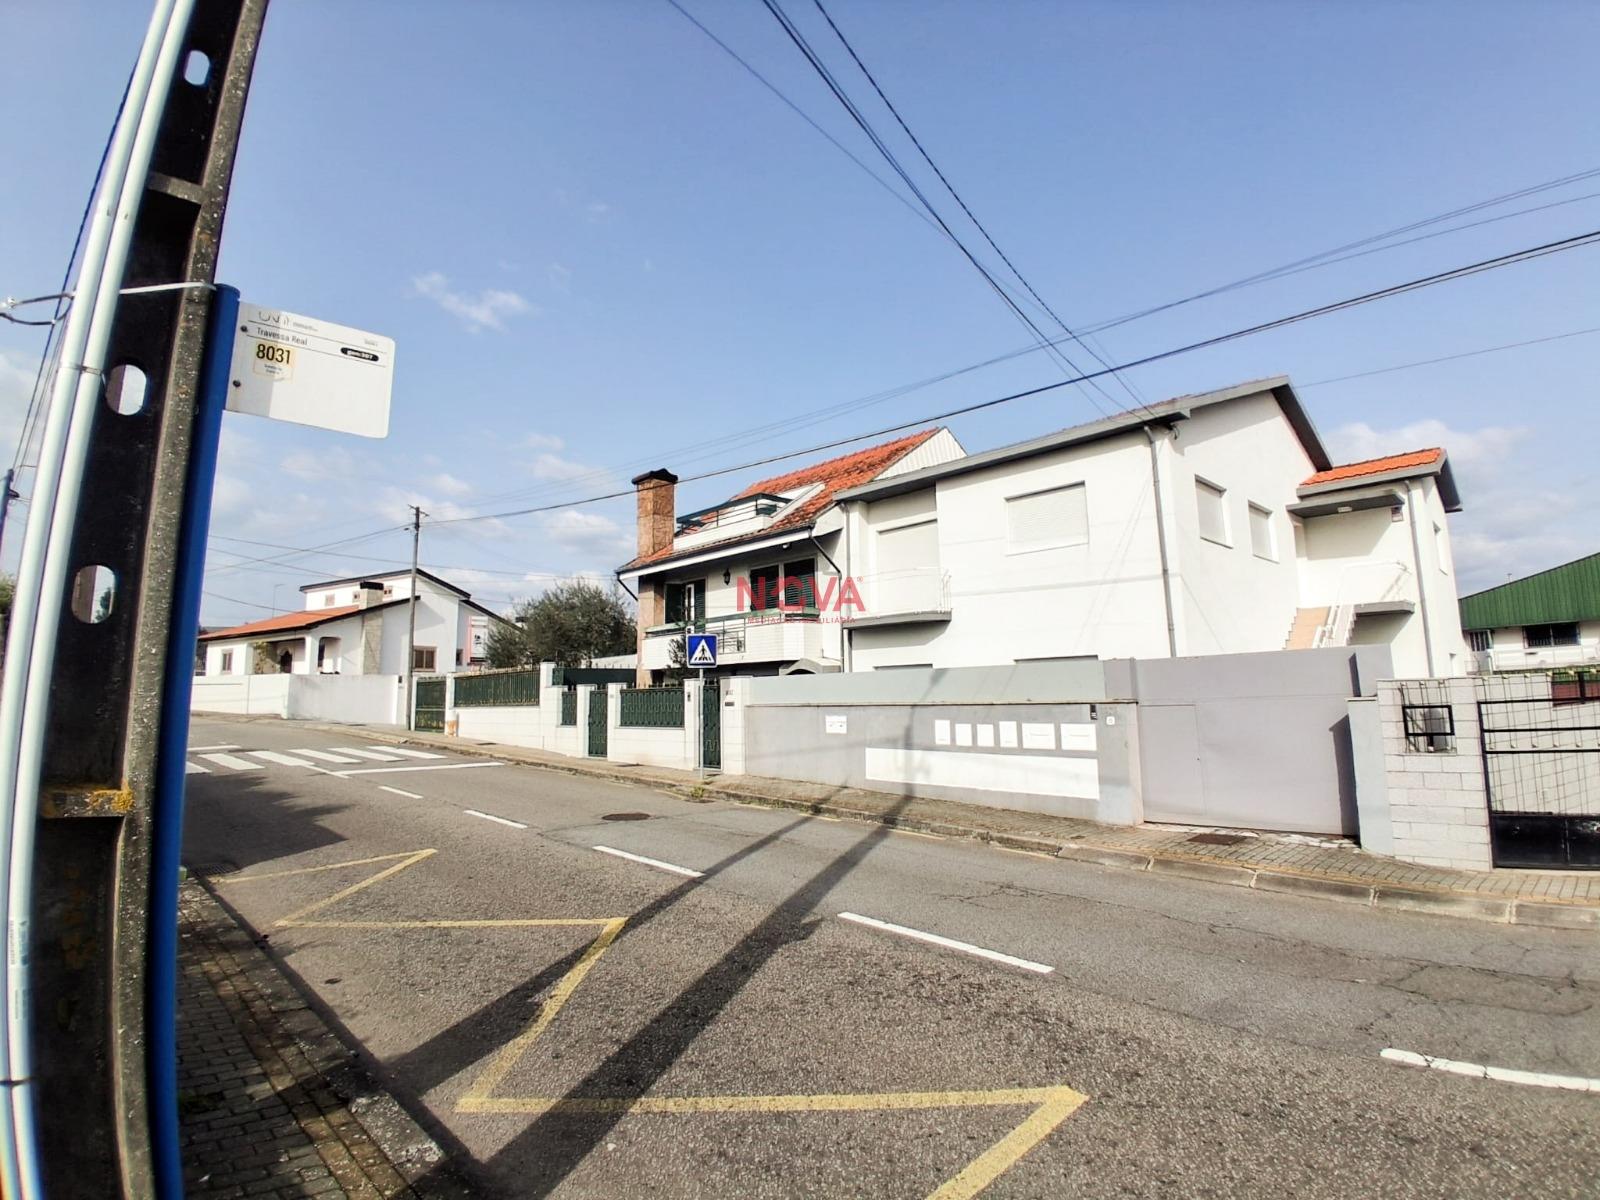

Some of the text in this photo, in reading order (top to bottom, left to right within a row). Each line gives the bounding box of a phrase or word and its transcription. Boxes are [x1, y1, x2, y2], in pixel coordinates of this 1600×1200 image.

[257, 327, 290, 342] Travessa
[292, 335, 308, 346] Real
[256, 343, 291, 365] 8031
